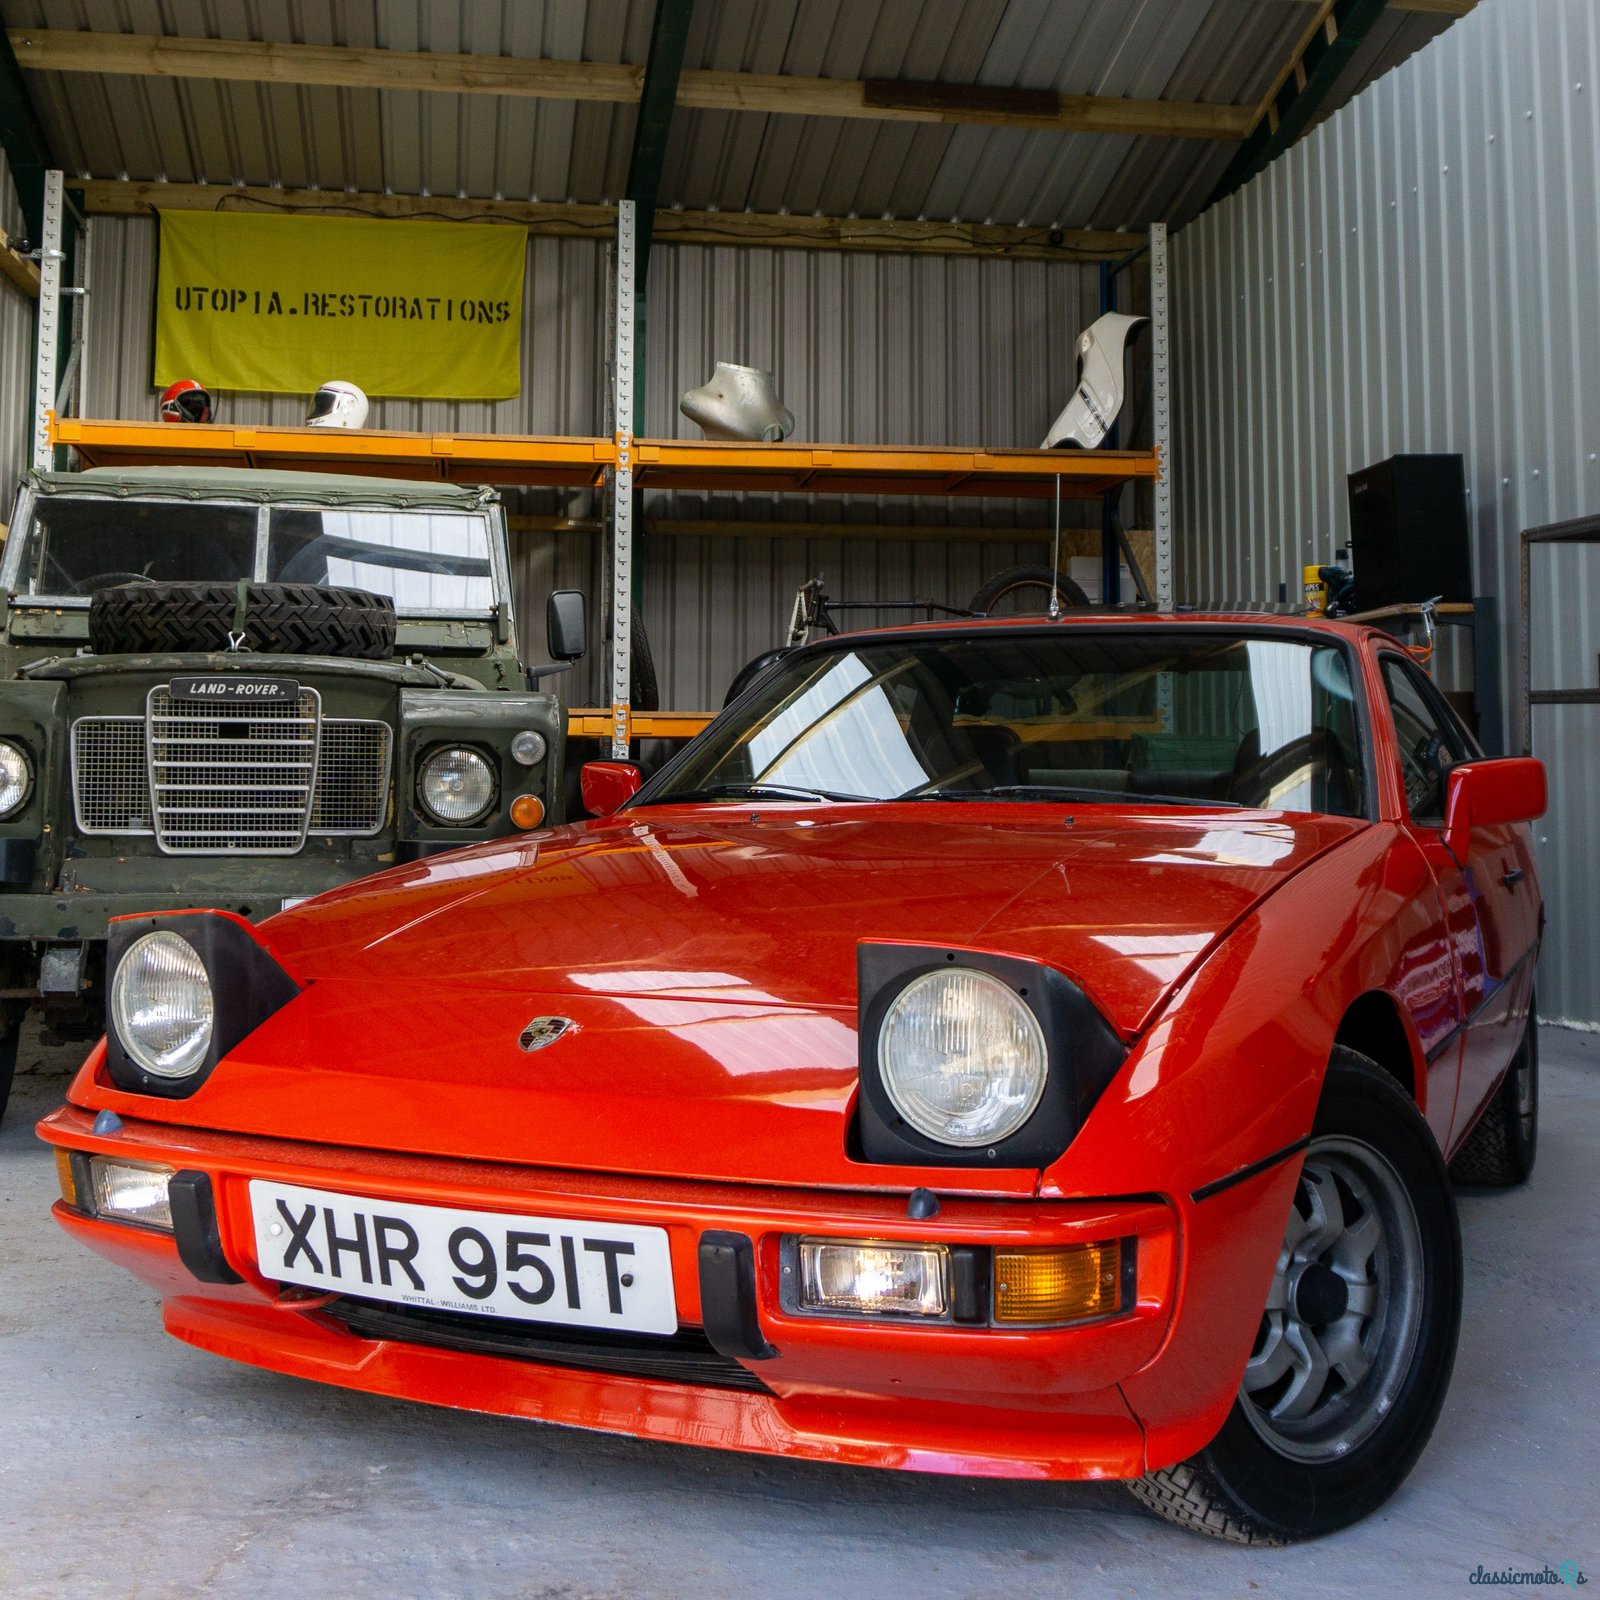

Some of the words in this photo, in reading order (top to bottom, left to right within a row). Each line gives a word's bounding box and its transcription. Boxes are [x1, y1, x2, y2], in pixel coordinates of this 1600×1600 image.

[189, 683, 279, 695] LAND-ROVER
[275, 1198, 426, 1292] XHR
[448, 1226, 636, 1315] 951T
